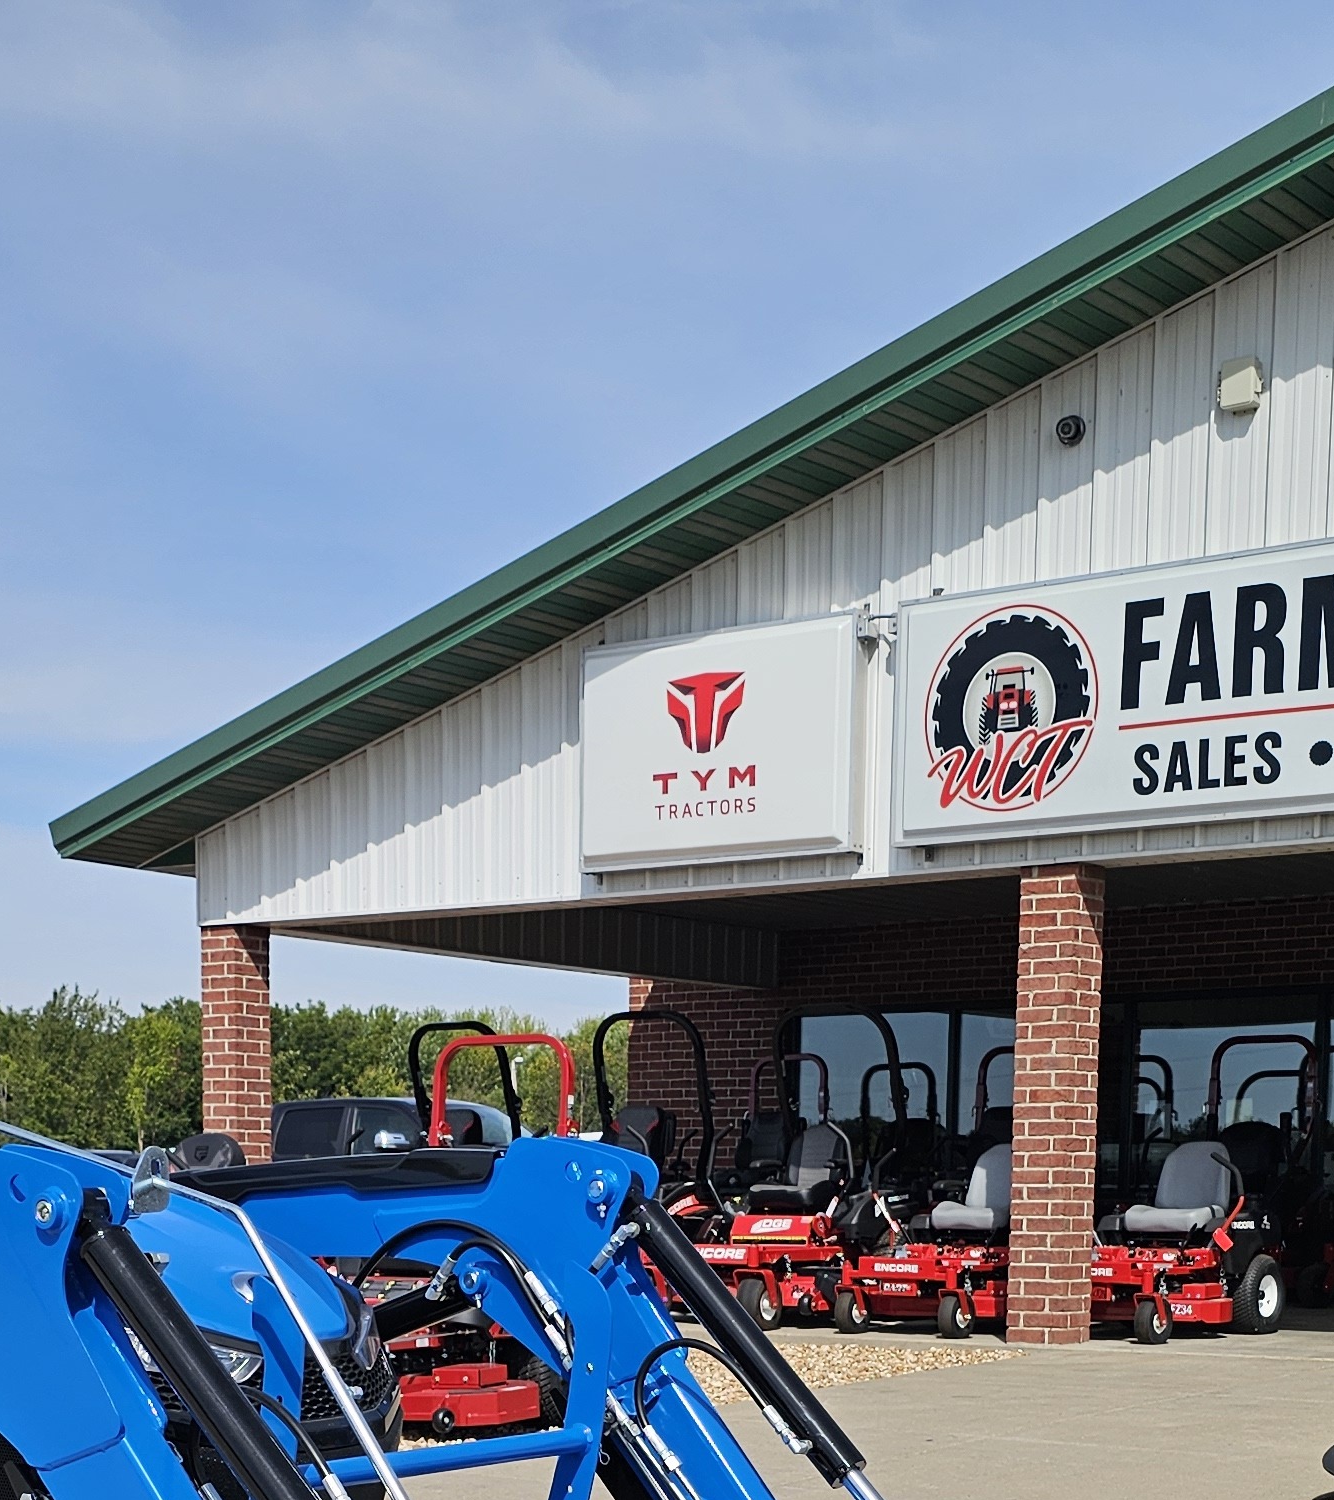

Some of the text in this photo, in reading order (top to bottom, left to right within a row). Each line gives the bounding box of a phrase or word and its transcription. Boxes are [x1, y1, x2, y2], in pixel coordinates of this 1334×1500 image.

[927, 718, 1093, 809] WCT
[1132, 731, 1282, 796] SALES
[652, 764, 757, 795] TYM
[654, 797, 757, 821] TRACTORS
[698, 1247, 746, 1259] NCORE
[874, 1262, 919, 1274] ENCORE
